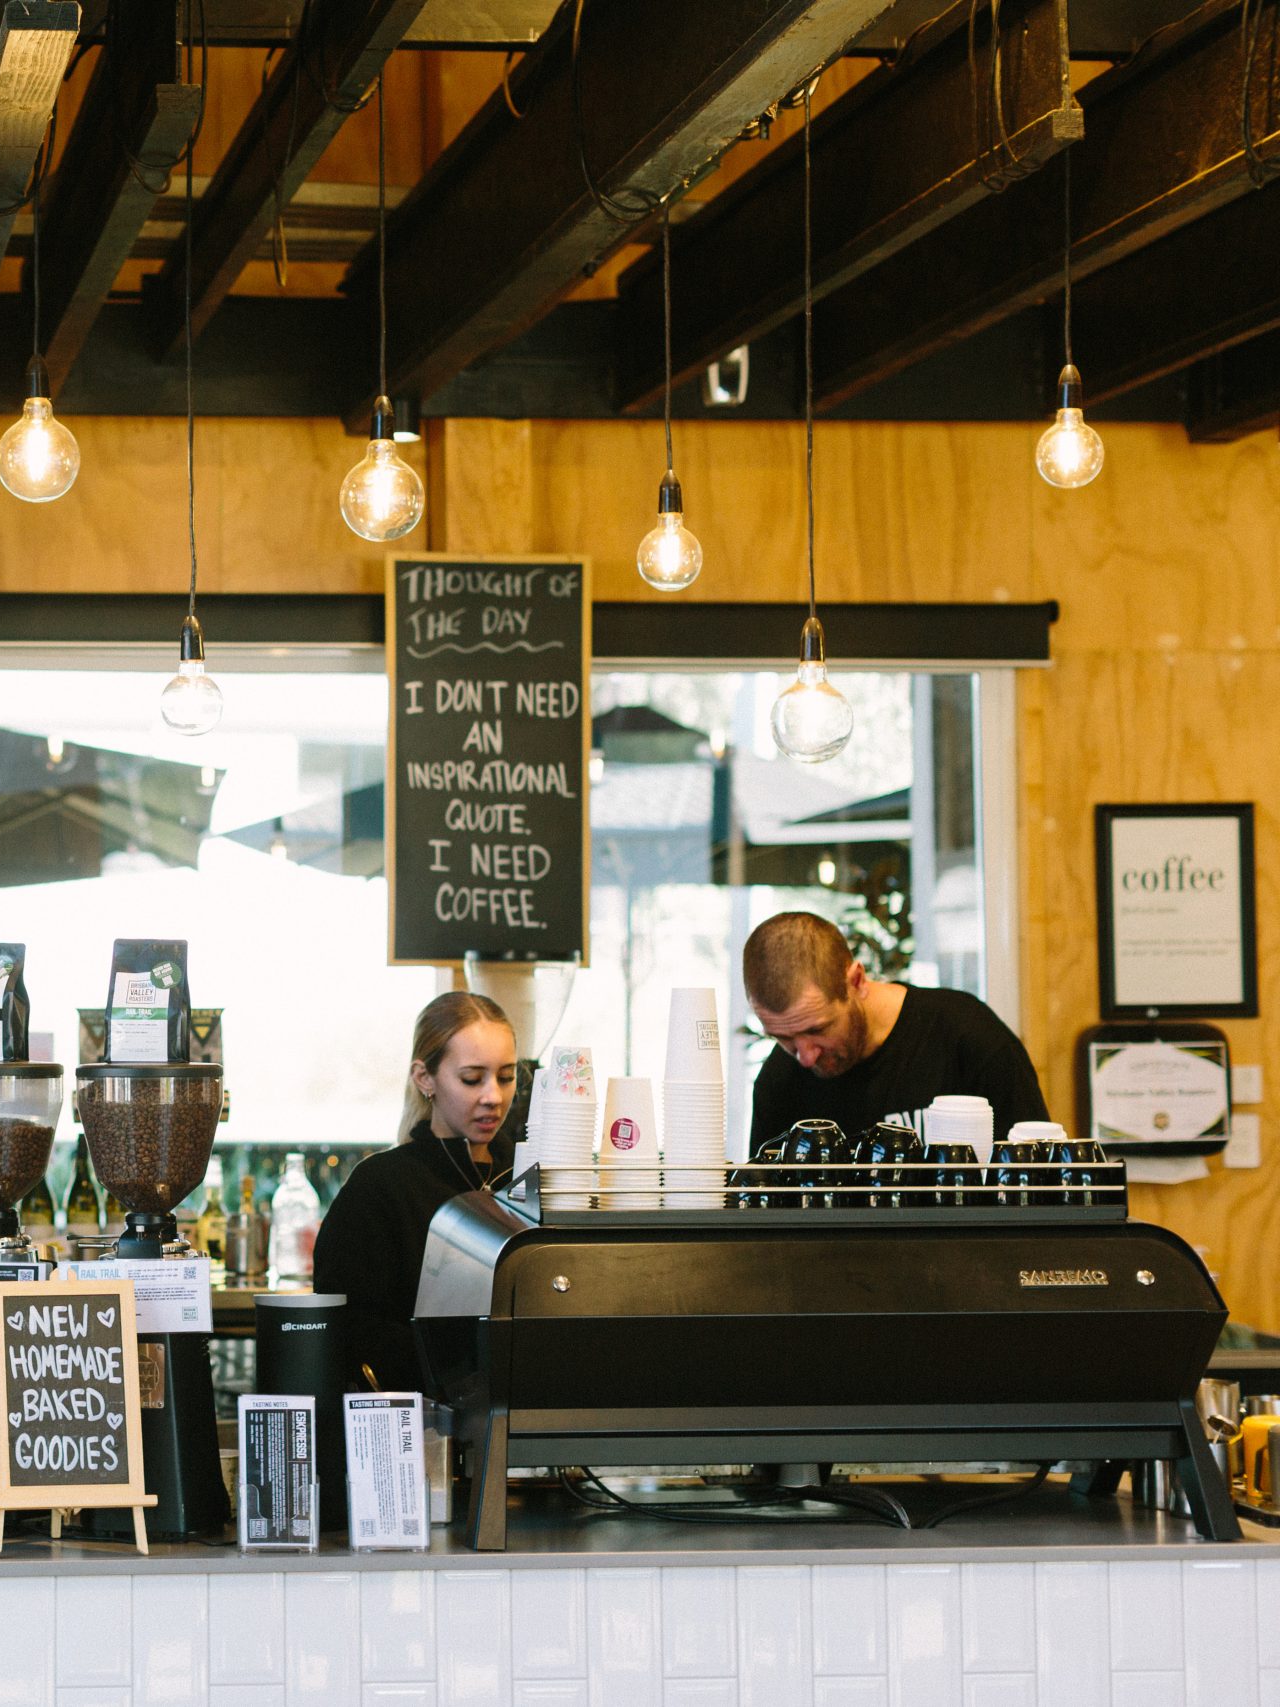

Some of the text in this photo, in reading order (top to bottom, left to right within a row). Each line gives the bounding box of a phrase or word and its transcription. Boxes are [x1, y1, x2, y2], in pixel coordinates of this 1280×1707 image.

[400, 567, 579, 602] THOUGHT OF
[406, 606, 533, 643] THE DAY
[404, 680, 425, 715] I
[516, 680, 580, 719] NEED
[462, 720, 503, 755] AN
[406, 761, 576, 798] INSPIRATIONAL
[444, 798, 532, 836] QUOTE.
[428, 839, 552, 882] I NEED
[1122, 854, 1224, 893] coffee
[434, 882, 548, 929] COFFEE.
[130, 988, 153, 996] VALLEY
[80, 1269, 98, 1279] RAIL
[100, 1268, 121, 1278] TRAIL
[28, 1303, 89, 1339] NEW
[8, 1344, 122, 1384] HOMEMADE
[22, 1387, 106, 1422] BAKED
[400, 1410, 410, 1428] RAIL
[15, 1432, 119, 1471] GOODIES
[295, 1411, 307, 1459] ESKPRESSO
[402, 1430, 413, 1454] TRAIL
